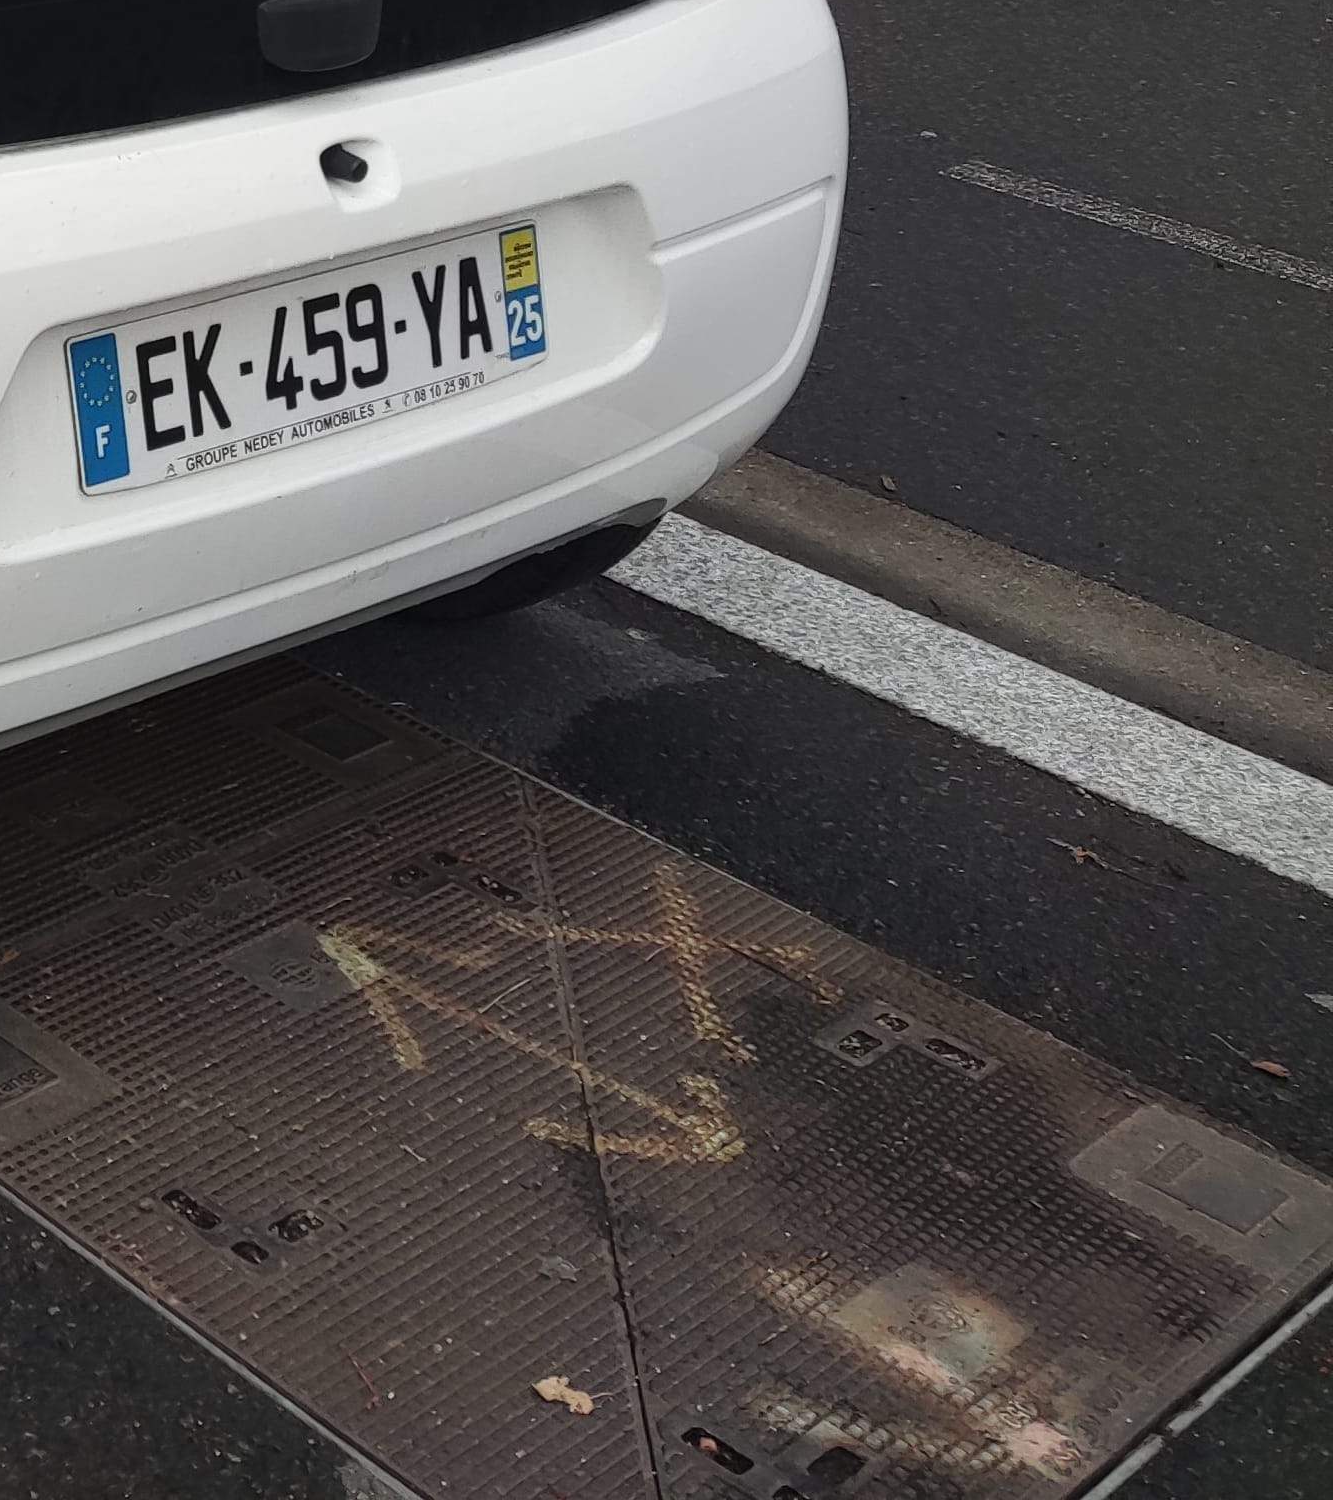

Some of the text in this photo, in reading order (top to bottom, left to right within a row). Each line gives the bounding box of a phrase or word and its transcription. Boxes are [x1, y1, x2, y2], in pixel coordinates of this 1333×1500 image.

[136, 256, 494, 451] EK-459-YA
[507, 295, 543, 347] 25
[94, 425, 110, 458] F
[185, 444, 238, 473] GROUPE
[244, 431, 284, 456] NEDEY
[291, 403, 375, 441] AUTOMOBILES
[458, 375, 470, 390] 90
[472, 371, 485, 386] 70
